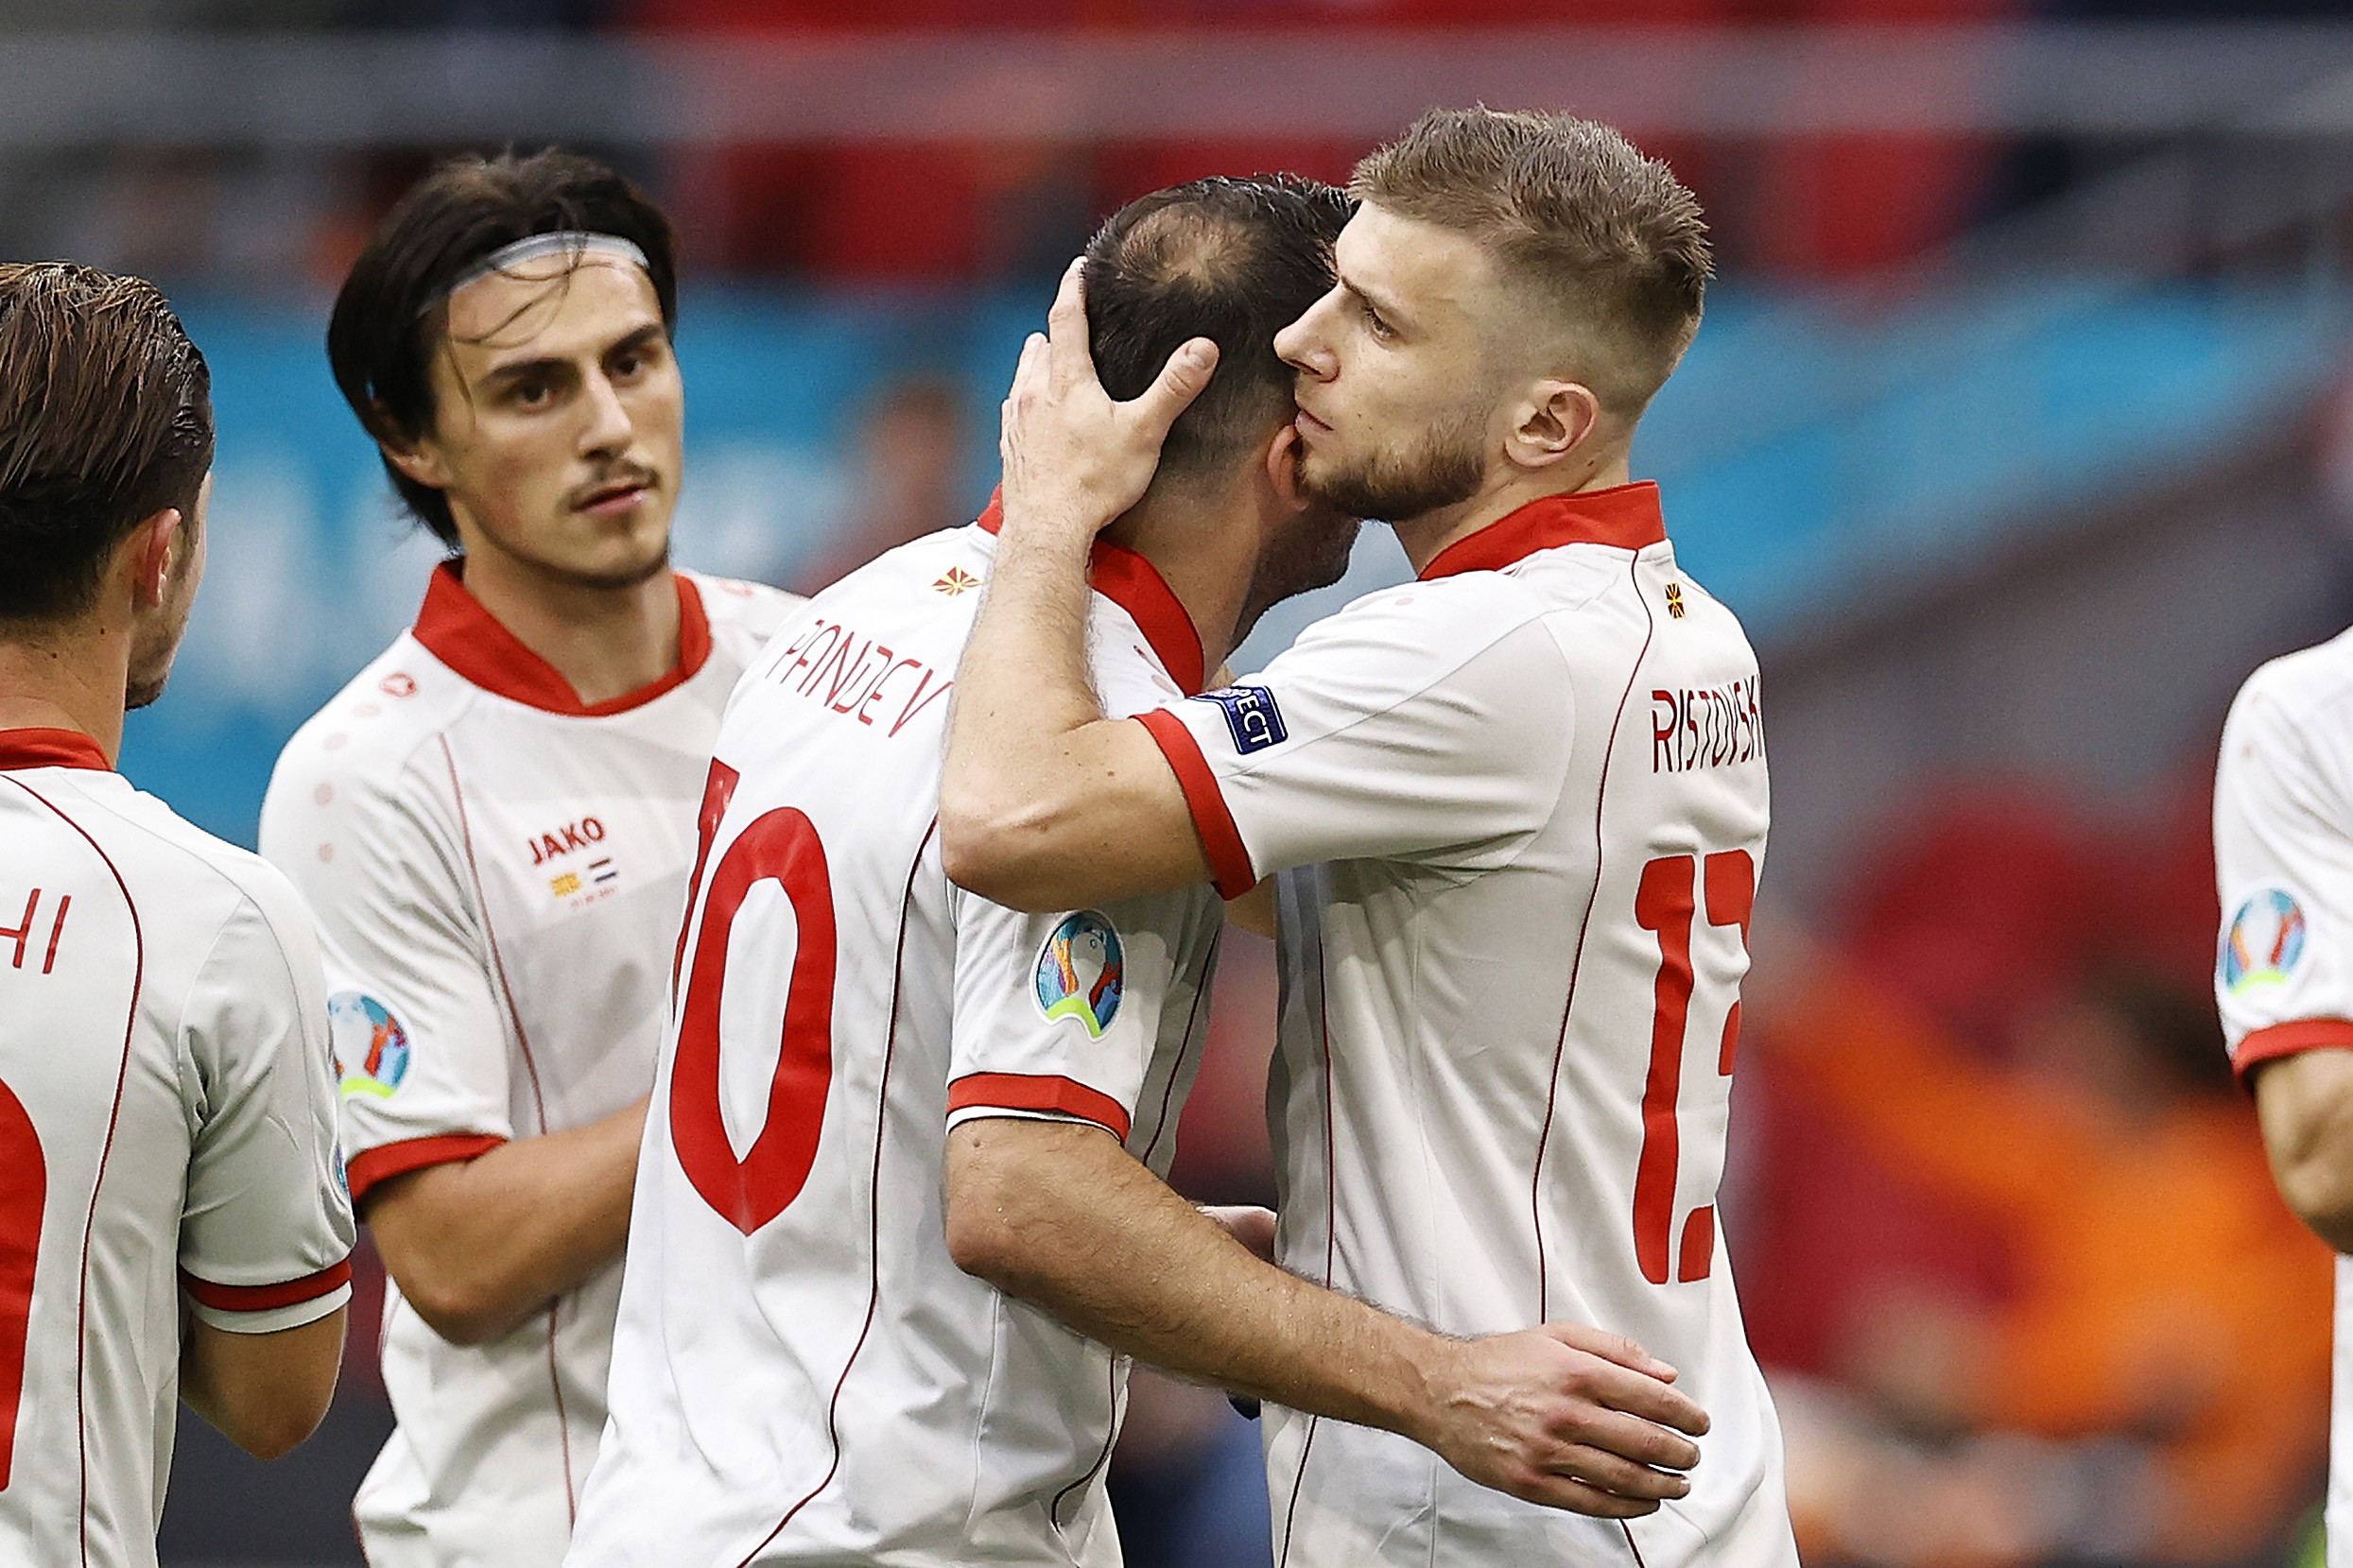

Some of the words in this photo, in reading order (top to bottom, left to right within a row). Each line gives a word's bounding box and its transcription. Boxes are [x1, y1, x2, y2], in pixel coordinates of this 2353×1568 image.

[765, 619, 954, 738] PANDEV
[1651, 674, 1762, 773] RISTOVSK
[528, 818, 605, 866] JAKO
